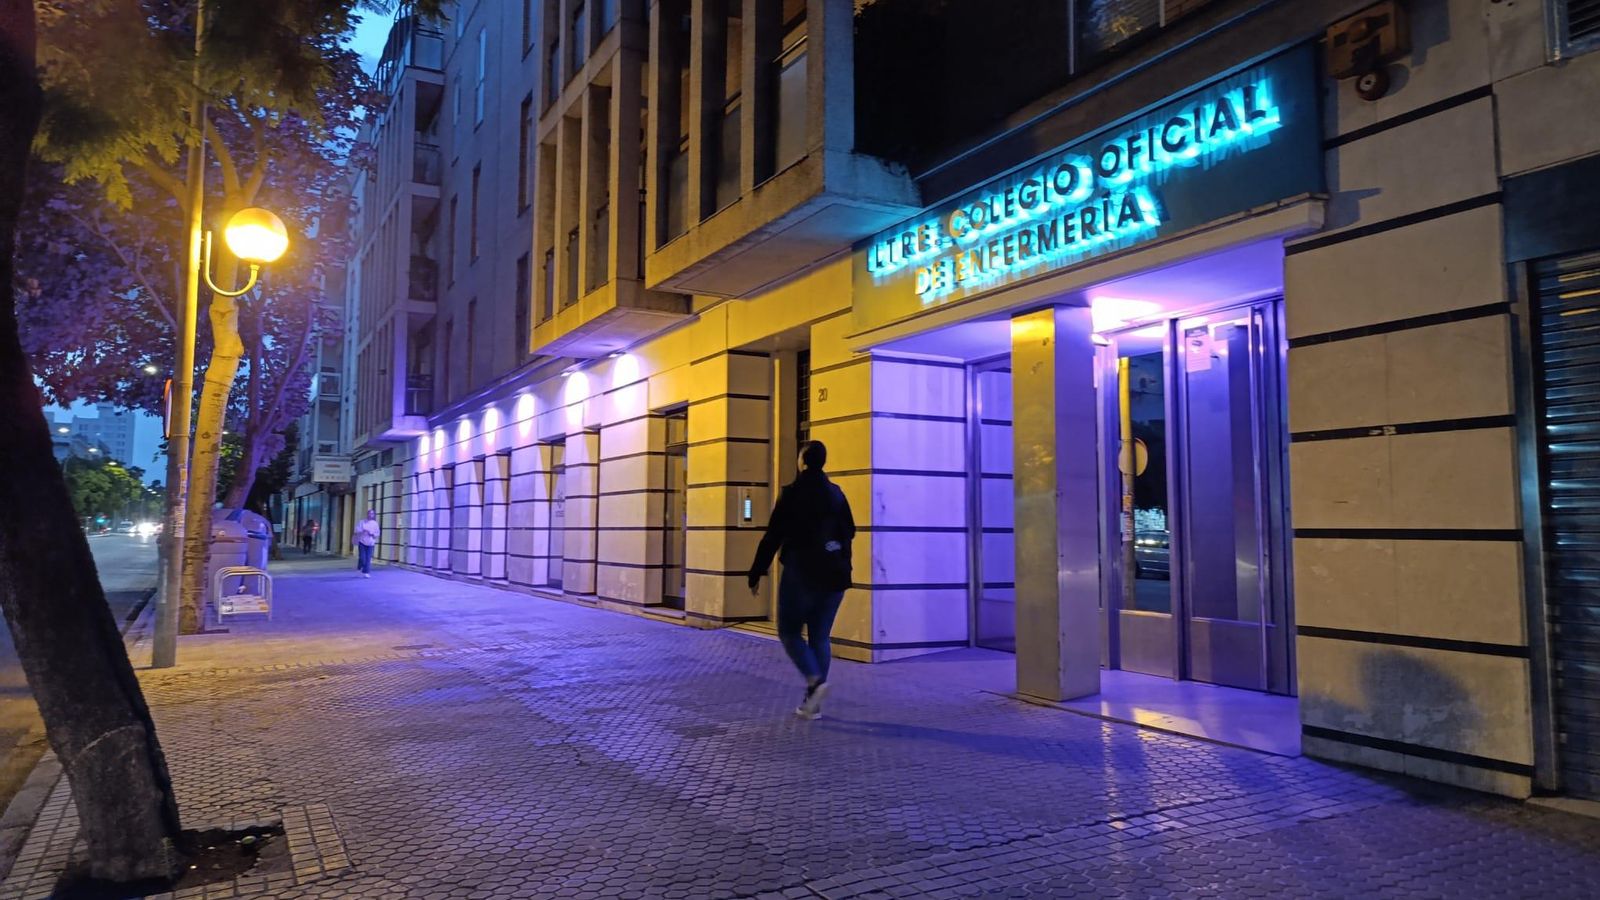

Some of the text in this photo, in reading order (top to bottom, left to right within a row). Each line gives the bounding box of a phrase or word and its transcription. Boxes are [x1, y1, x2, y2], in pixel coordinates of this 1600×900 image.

[950, 163, 1080, 238] COLEGIO
[1099, 85, 1267, 179] OFICIAL
[914, 191, 1145, 295] DE ENFERMERÍA
[818, 387, 828, 402] 20
